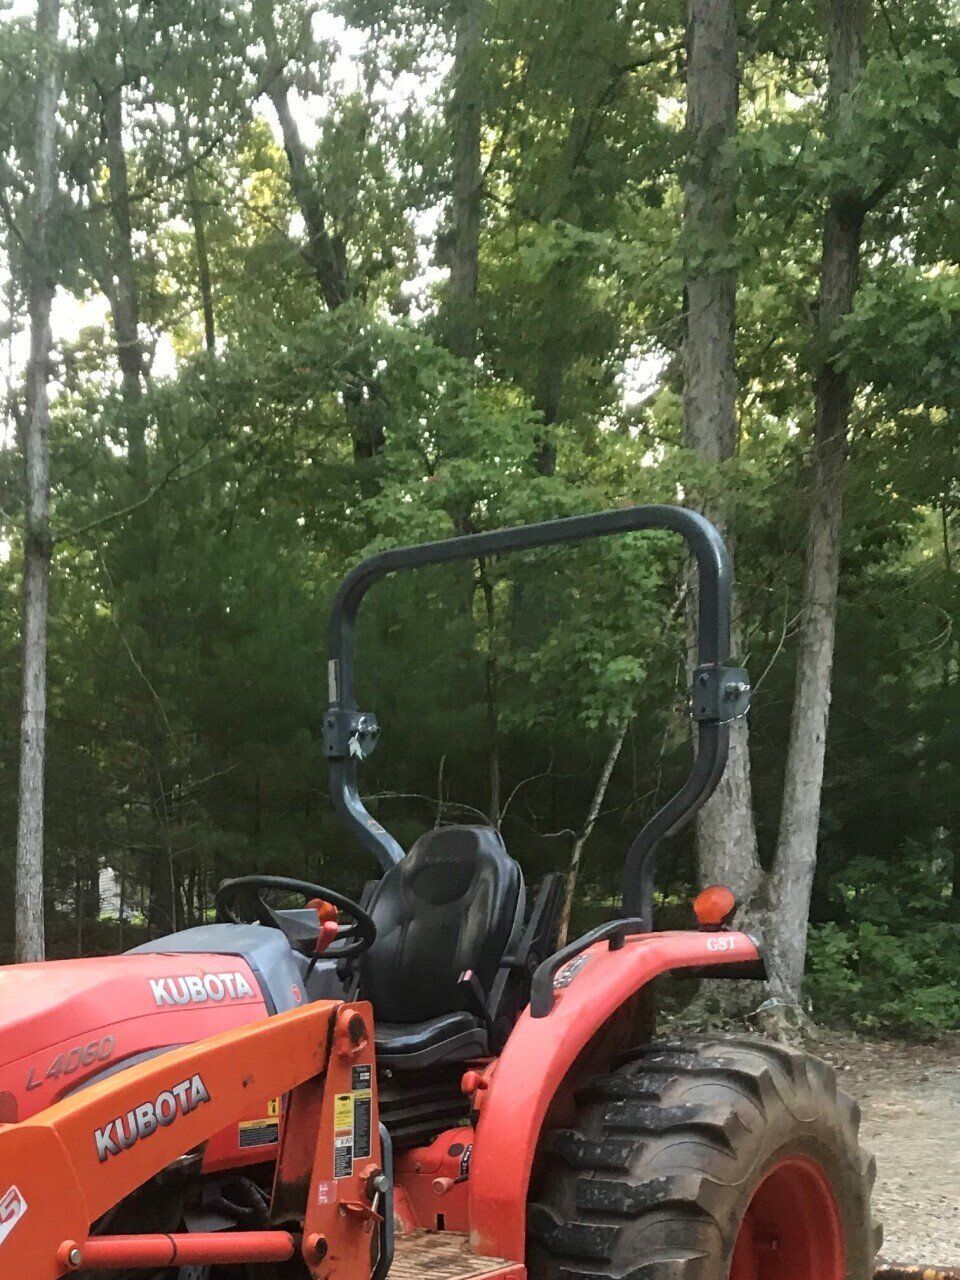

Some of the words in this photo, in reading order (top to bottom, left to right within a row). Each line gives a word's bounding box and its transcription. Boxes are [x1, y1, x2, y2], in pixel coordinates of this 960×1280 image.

[148, 972, 256, 1006] KUBOTA
[25, 1034, 115, 1091] L4060
[94, 1073, 210, 1163] KUBOTA
